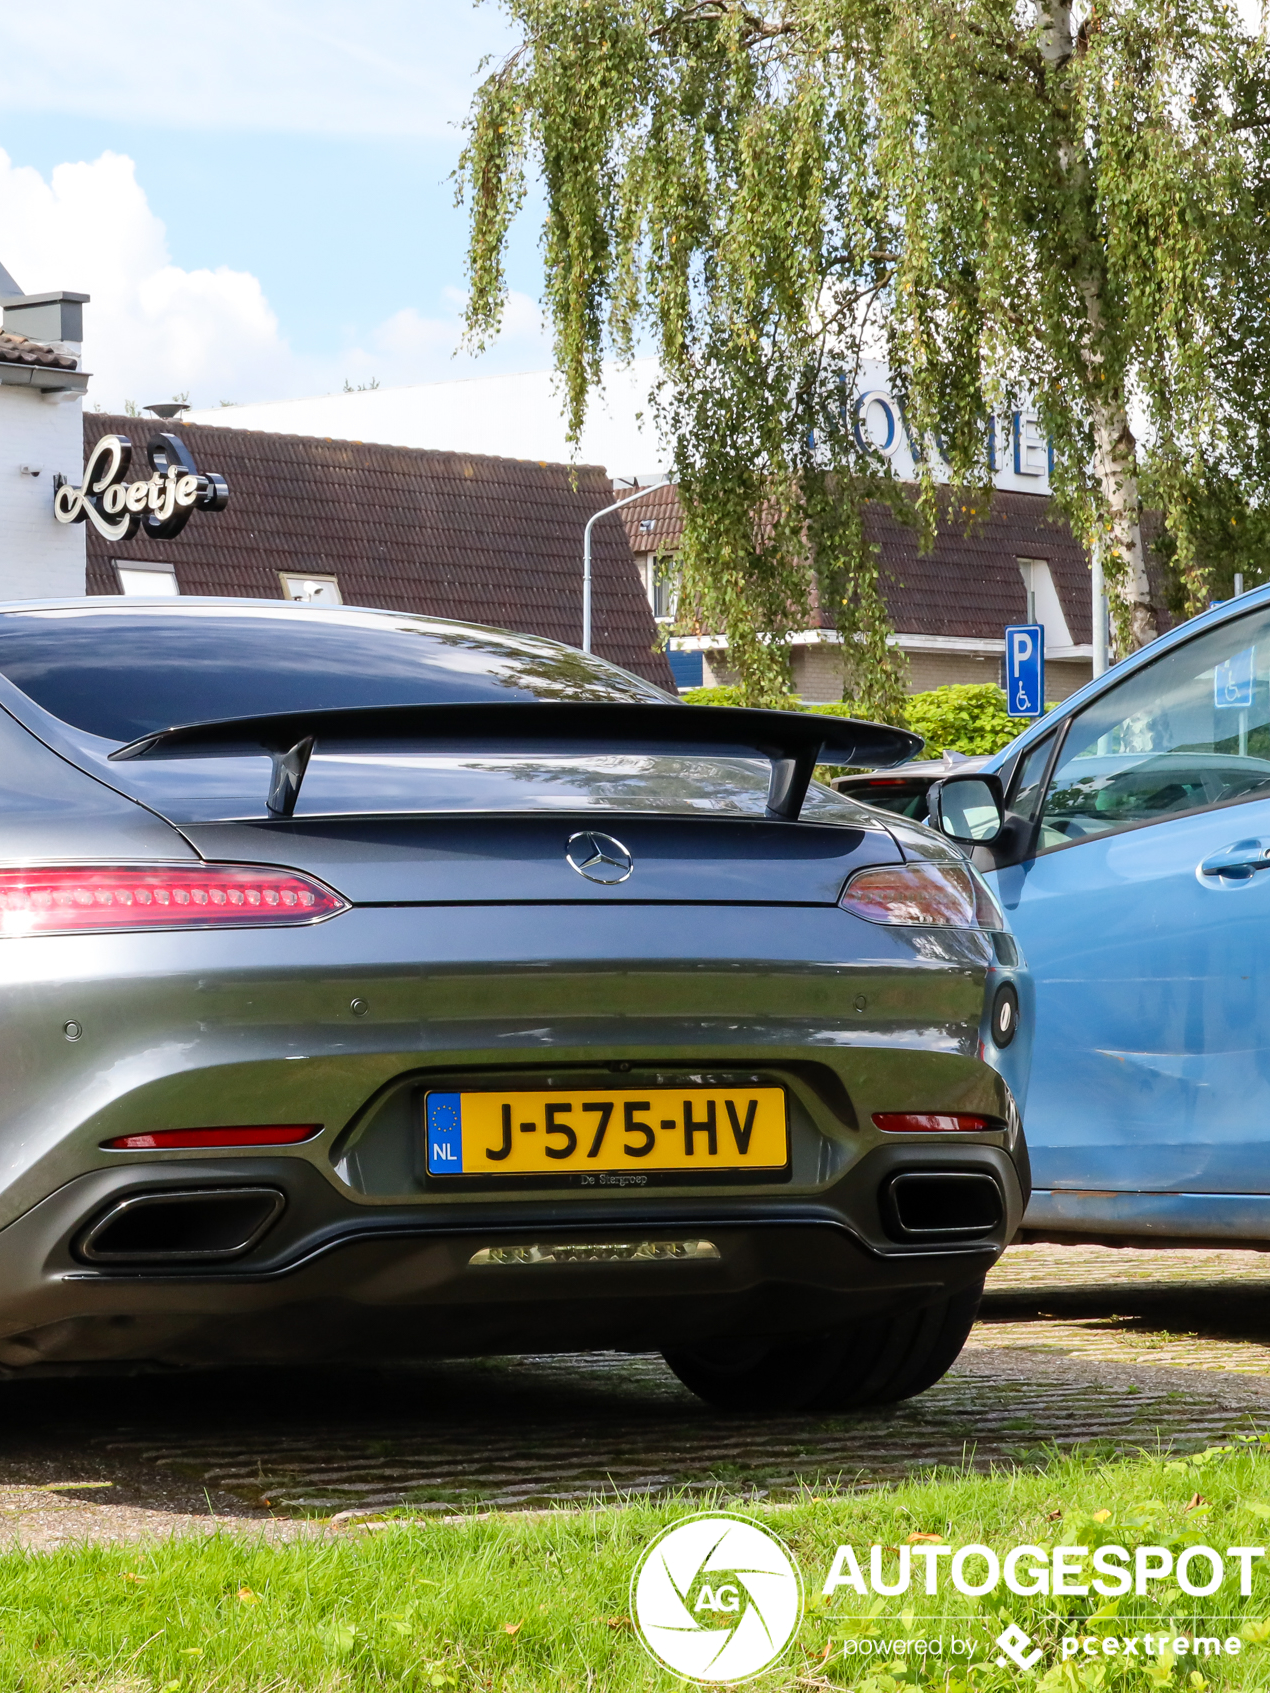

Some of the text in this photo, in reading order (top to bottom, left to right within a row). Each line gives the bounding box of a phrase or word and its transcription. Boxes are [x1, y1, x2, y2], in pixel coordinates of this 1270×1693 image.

[55, 434, 200, 541] Loetje
[1013, 632, 1033, 678] P
[433, 1143, 458, 1161] NL
[485, 1099, 759, 1161] J-575-HV
[580, 1174, 595, 1185] De
